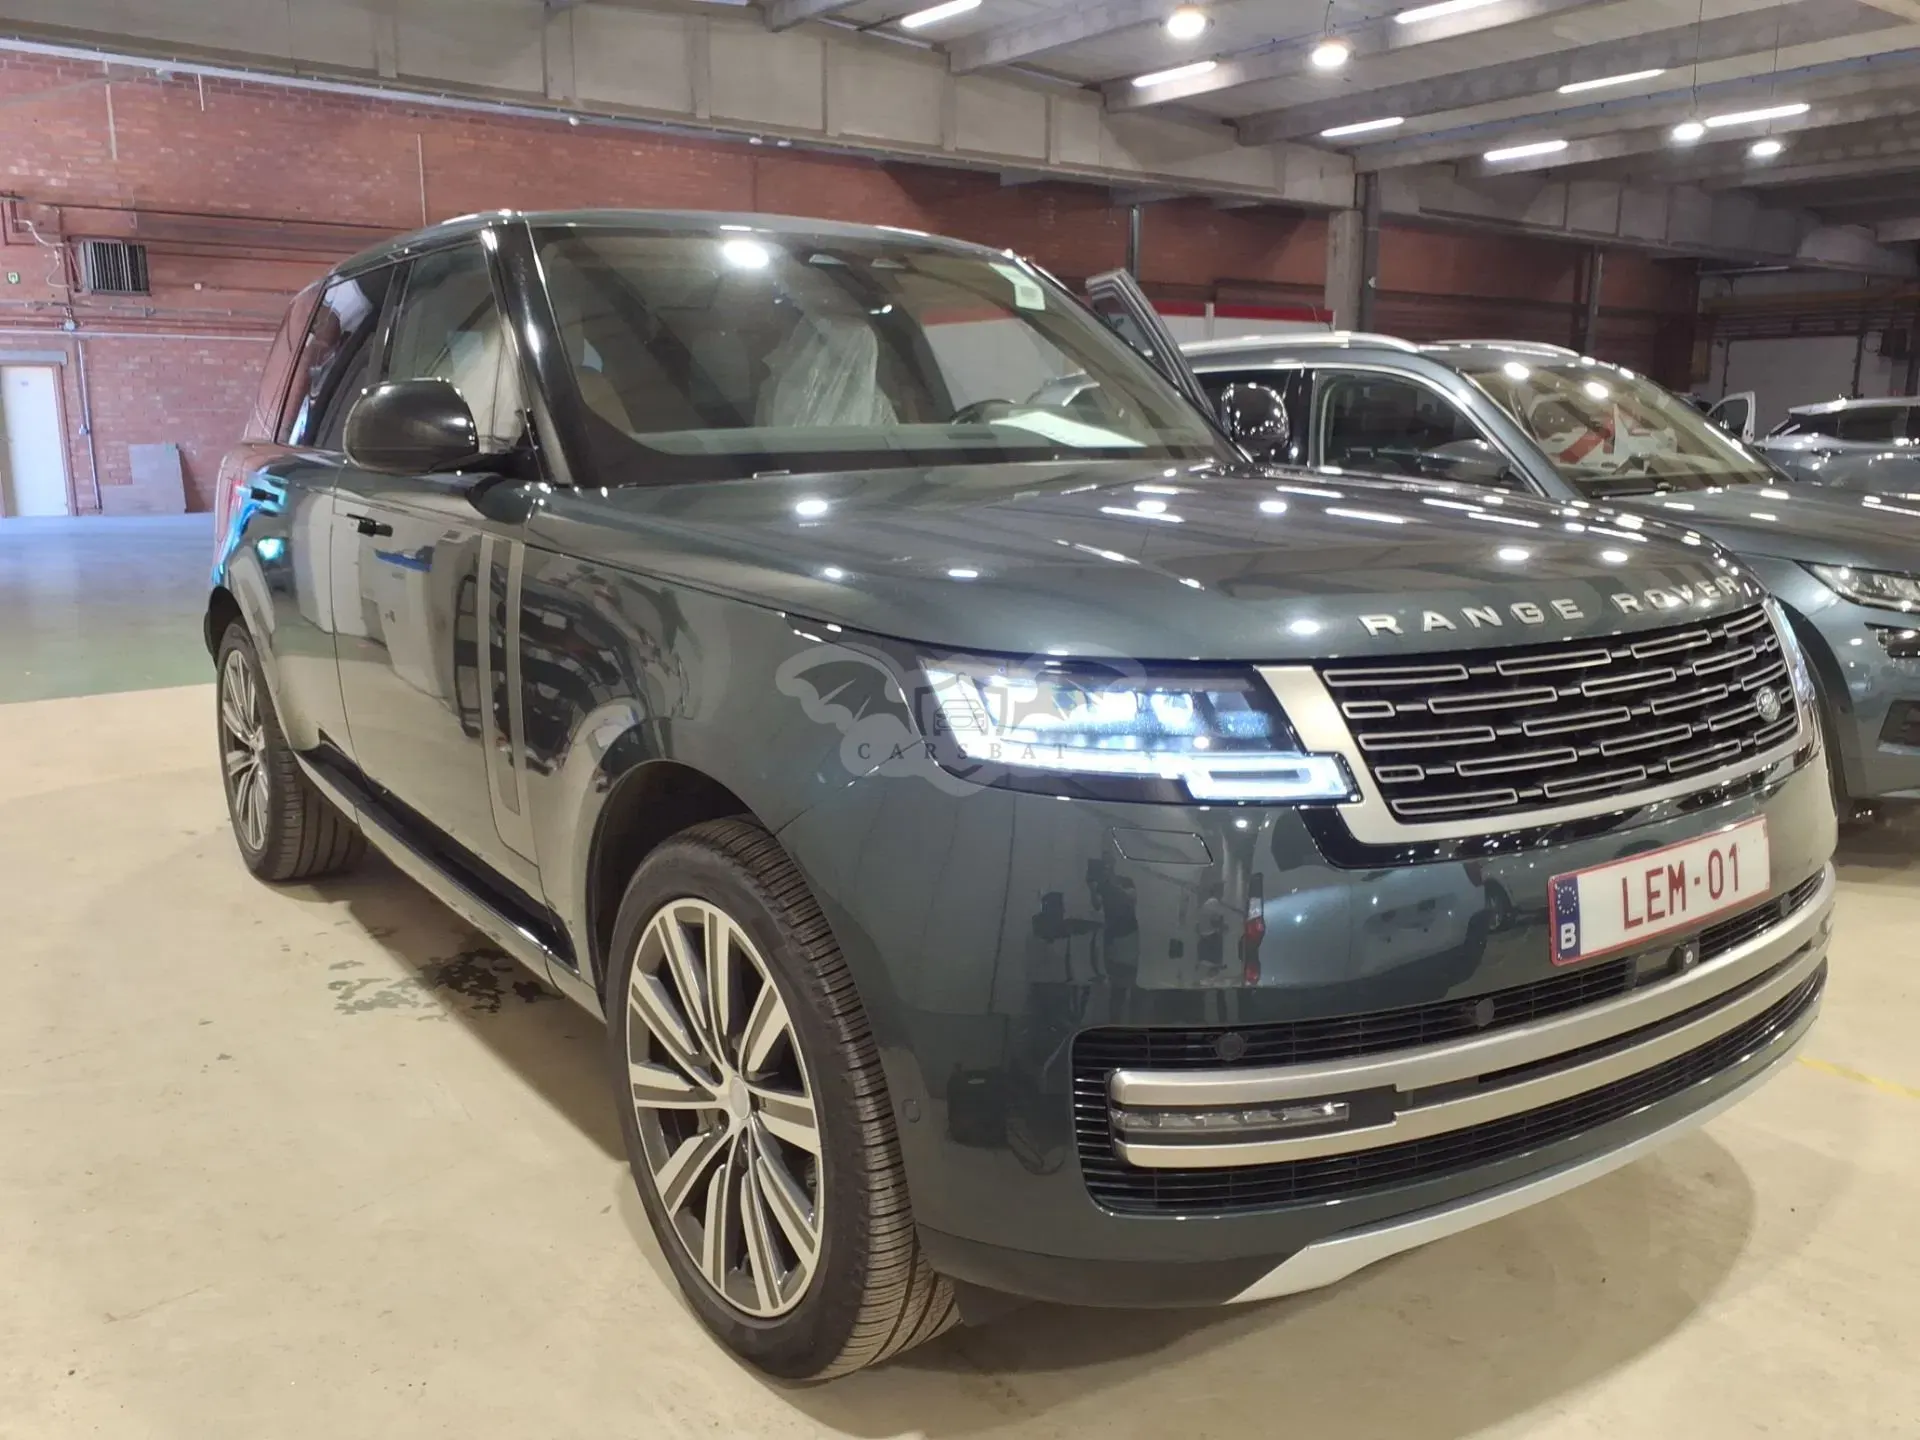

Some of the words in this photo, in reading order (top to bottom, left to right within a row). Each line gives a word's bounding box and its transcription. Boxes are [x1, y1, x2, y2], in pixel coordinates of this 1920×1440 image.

[1357, 598, 1585, 636] RANGE
[1610, 575, 1741, 615] ROVER
[1621, 842, 1739, 930] LEM-01
[1560, 922, 1577, 950] B
